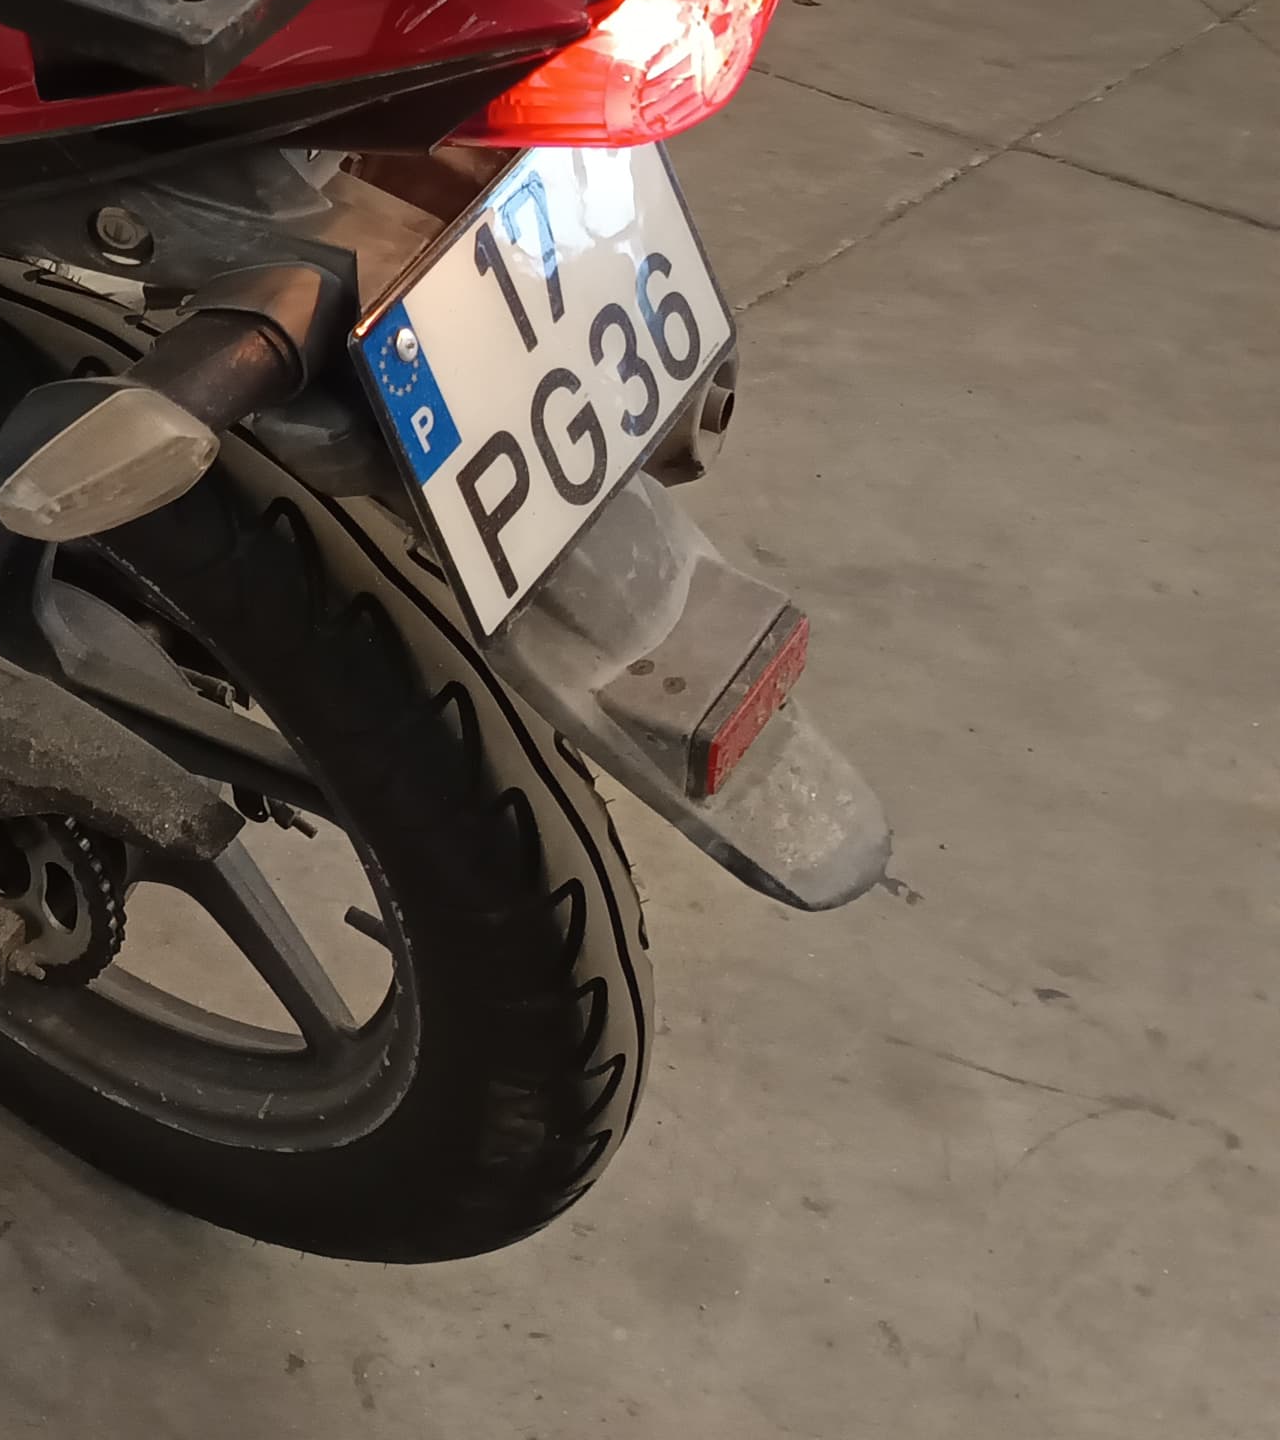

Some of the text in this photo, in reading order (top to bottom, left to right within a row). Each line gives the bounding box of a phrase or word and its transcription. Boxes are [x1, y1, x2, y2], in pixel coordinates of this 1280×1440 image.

[473, 168, 564, 353] 17
[409, 405, 435, 454] P
[455, 251, 701, 600] PG36
